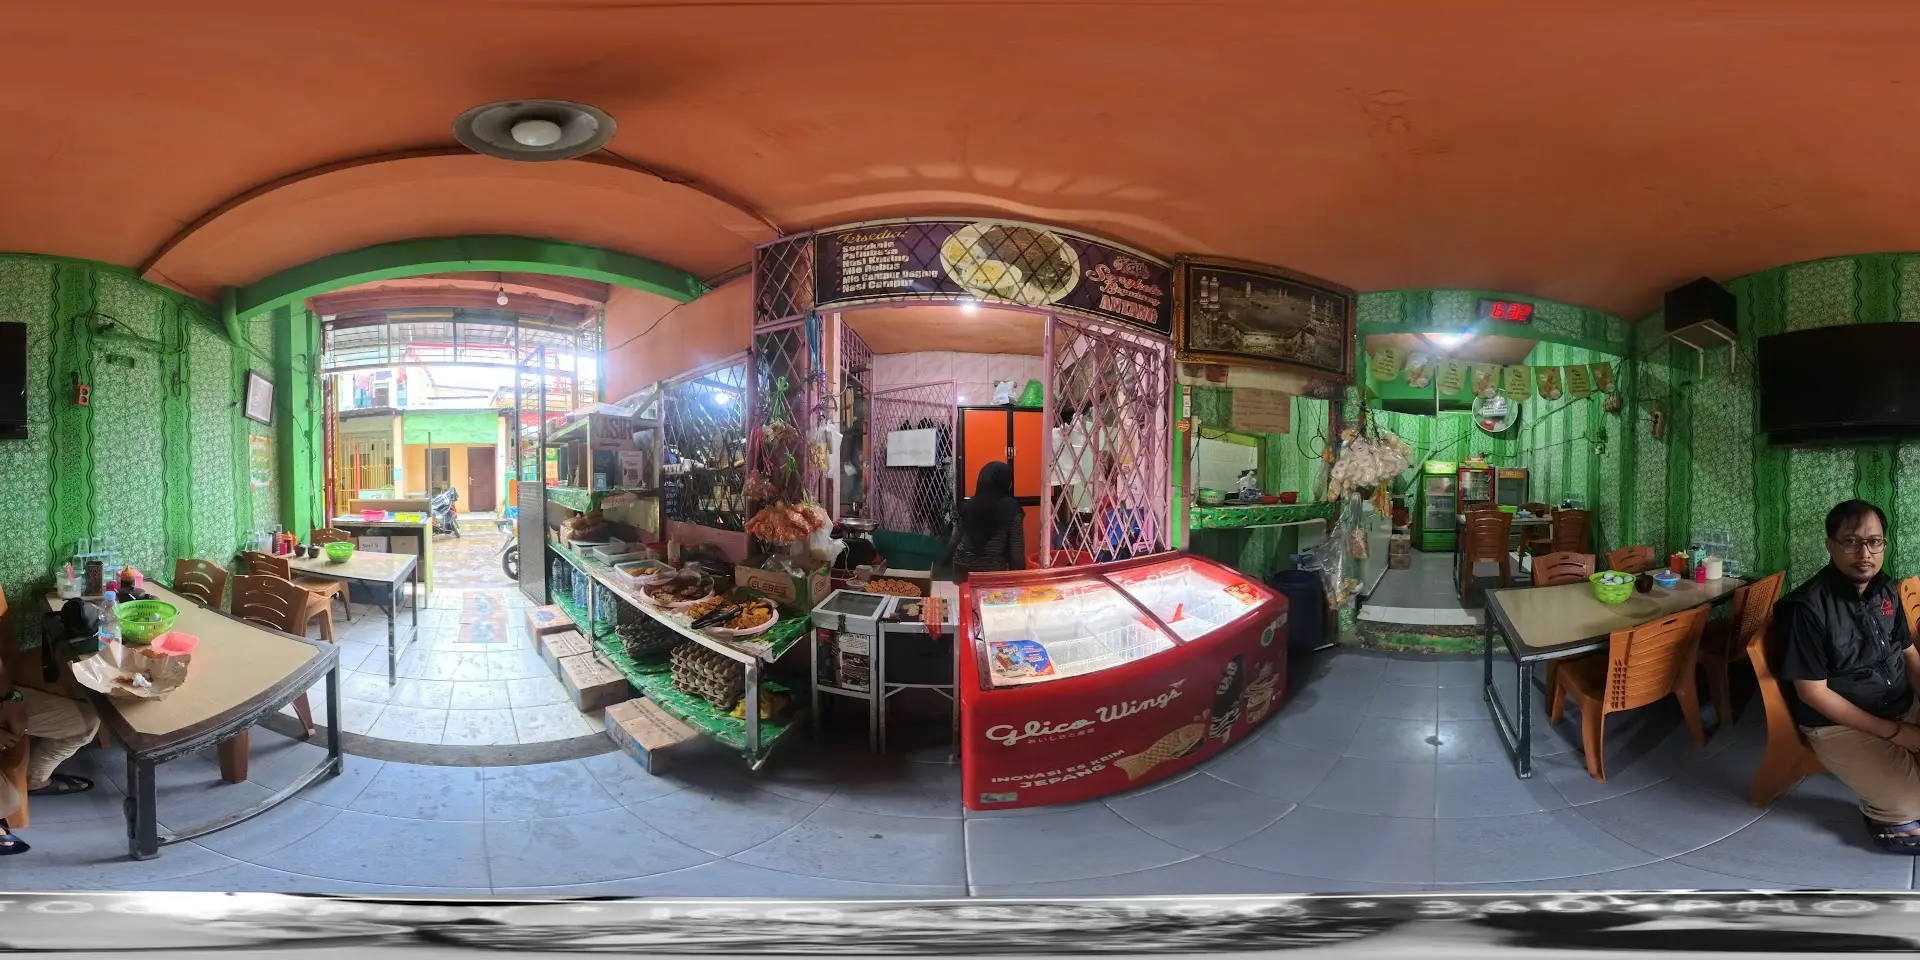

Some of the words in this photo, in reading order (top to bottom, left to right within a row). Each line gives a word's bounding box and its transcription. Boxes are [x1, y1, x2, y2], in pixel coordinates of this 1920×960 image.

[842, 257, 866, 268] Nasi
[842, 282, 866, 293] Nasi
[1099, 294, 1159, 325] ANTANG
[985, 719, 1096, 746] Glico
[1095, 689, 1183, 723] Wings
[991, 769, 1061, 783] INOVASI
[1066, 763, 1088, 773] ES
[1090, 749, 1126, 766] KRIM
[1019, 764, 1107, 789] JEPANG
